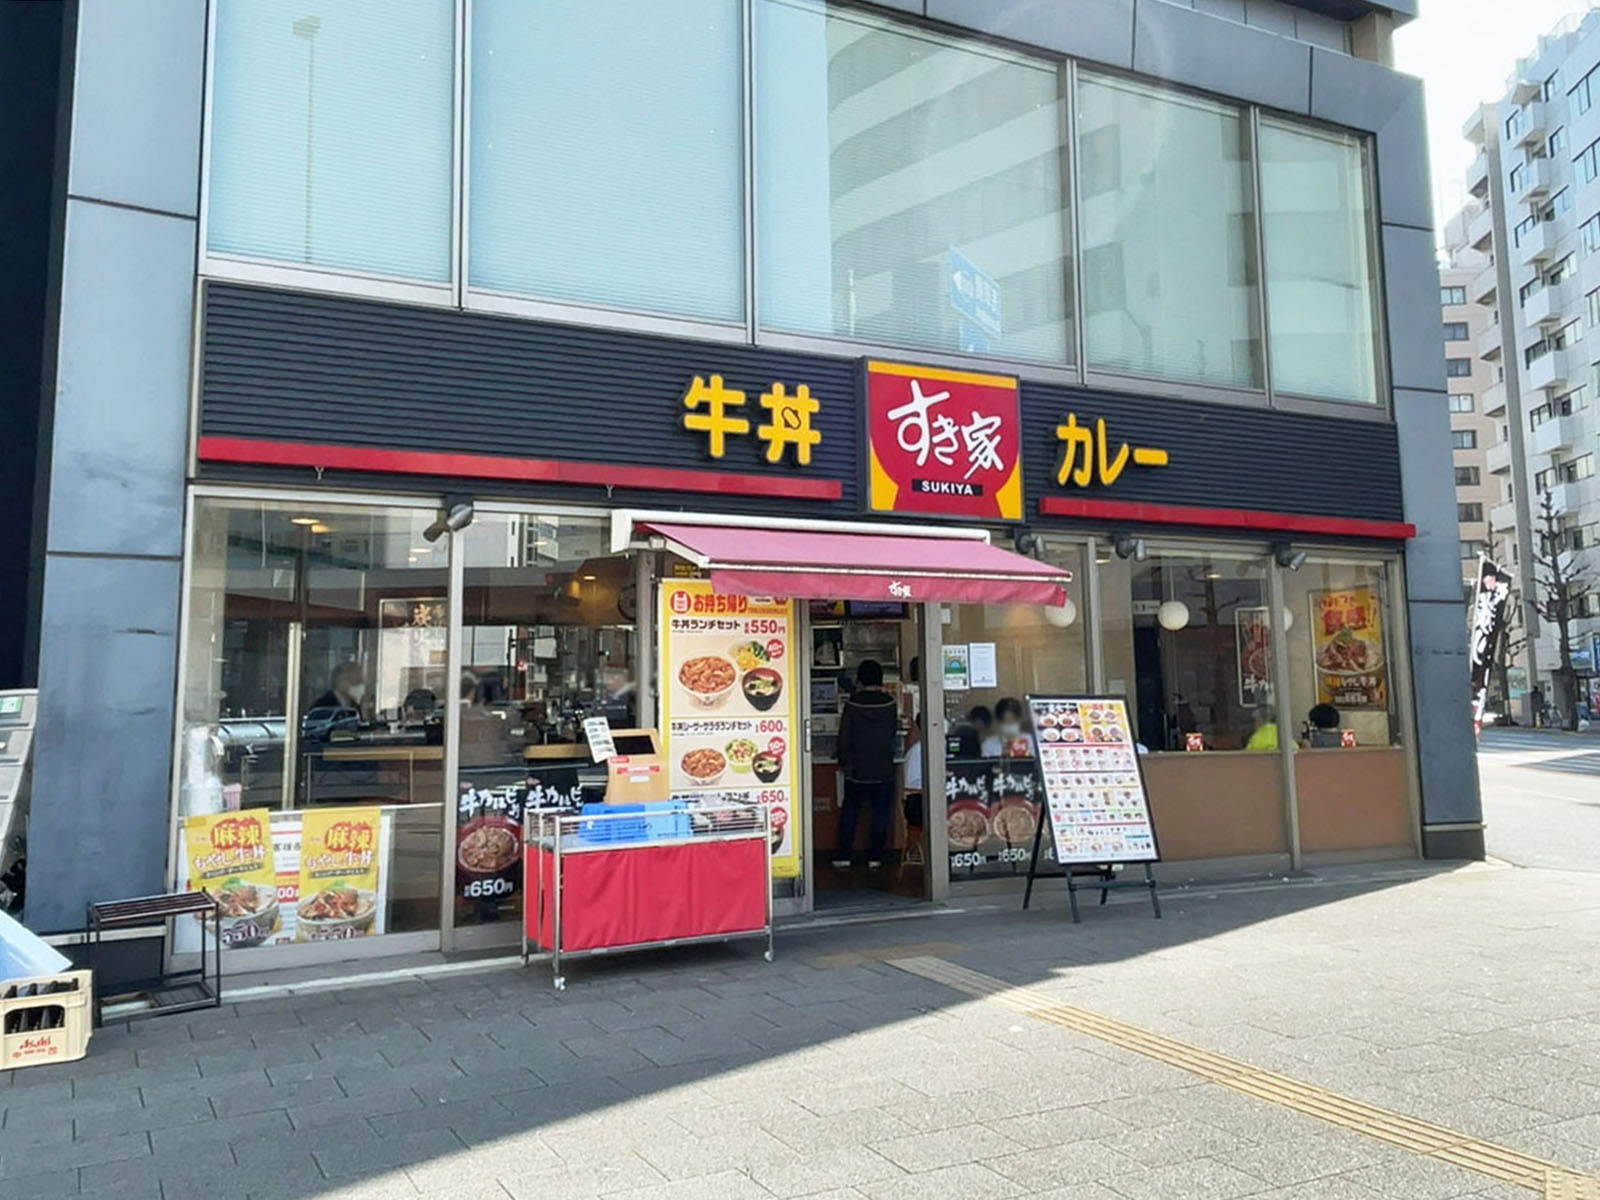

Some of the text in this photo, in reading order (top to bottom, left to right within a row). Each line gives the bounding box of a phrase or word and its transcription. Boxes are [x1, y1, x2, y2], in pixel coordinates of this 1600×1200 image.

[684, 374, 821, 465] 牛丼
[887, 379, 1005, 480] すき家
[1056, 412, 1169, 486] カレー
[920, 479, 975, 496] SUKIYA
